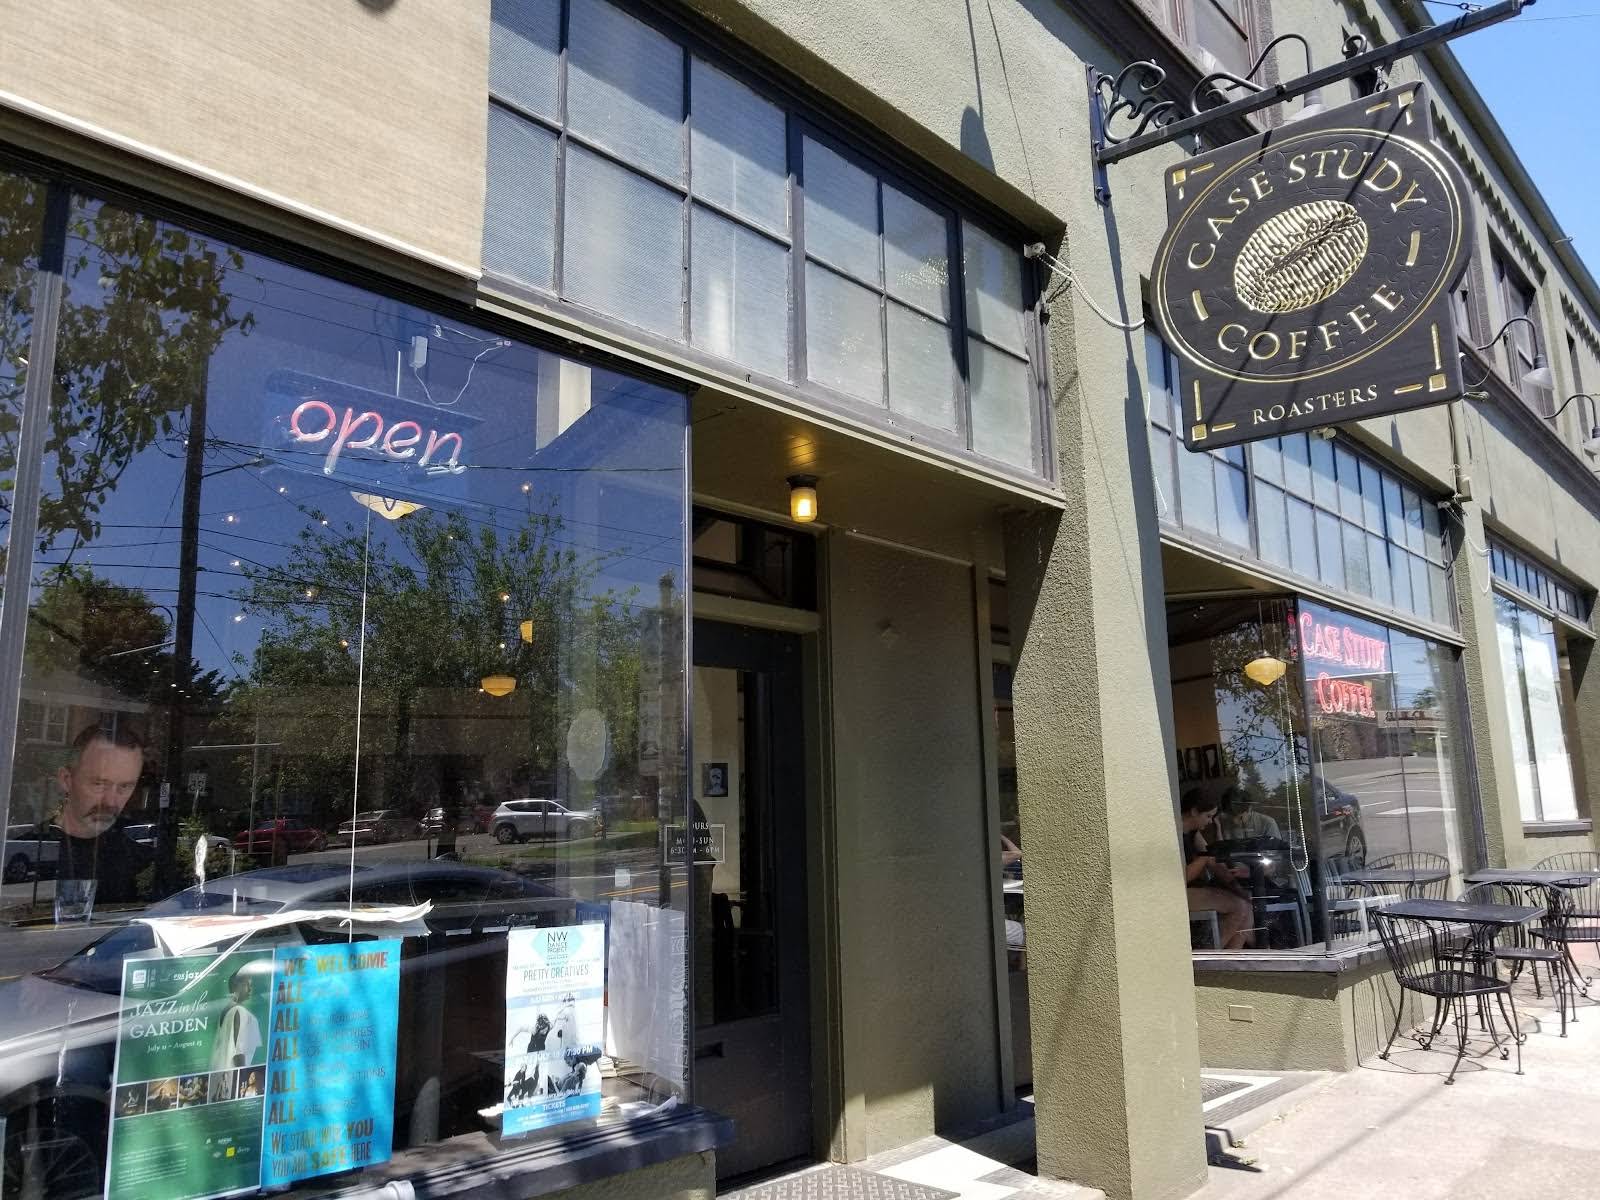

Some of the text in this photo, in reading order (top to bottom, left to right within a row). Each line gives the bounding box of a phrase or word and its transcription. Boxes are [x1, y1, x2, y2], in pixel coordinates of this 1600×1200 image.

[1188, 148, 1428, 269] CASE STUDY
[1217, 284, 1404, 360] COFFEE
[1252, 385, 1378, 425] ROASTERS
[290, 400, 464, 475] open
[547, 931, 569, 943] NW
[523, 967, 549, 982] PRETTY
[550, 964, 590, 979] CREATIVES
[276, 981, 304, 1005] ALL
[130, 1000, 178, 1017] JAZZ
[274, 1008, 300, 1032] ALL
[130, 1016, 209, 1039] GARDEN
[147, 1043, 160, 1053] July
[173, 1040, 195, 1049] August
[271, 1037, 300, 1062] ALL
[270, 1068, 299, 1095] ALL
[268, 1099, 296, 1125] ALL
[346, 1117, 374, 1140] YOU
[351, 1140, 373, 1162] HERE
